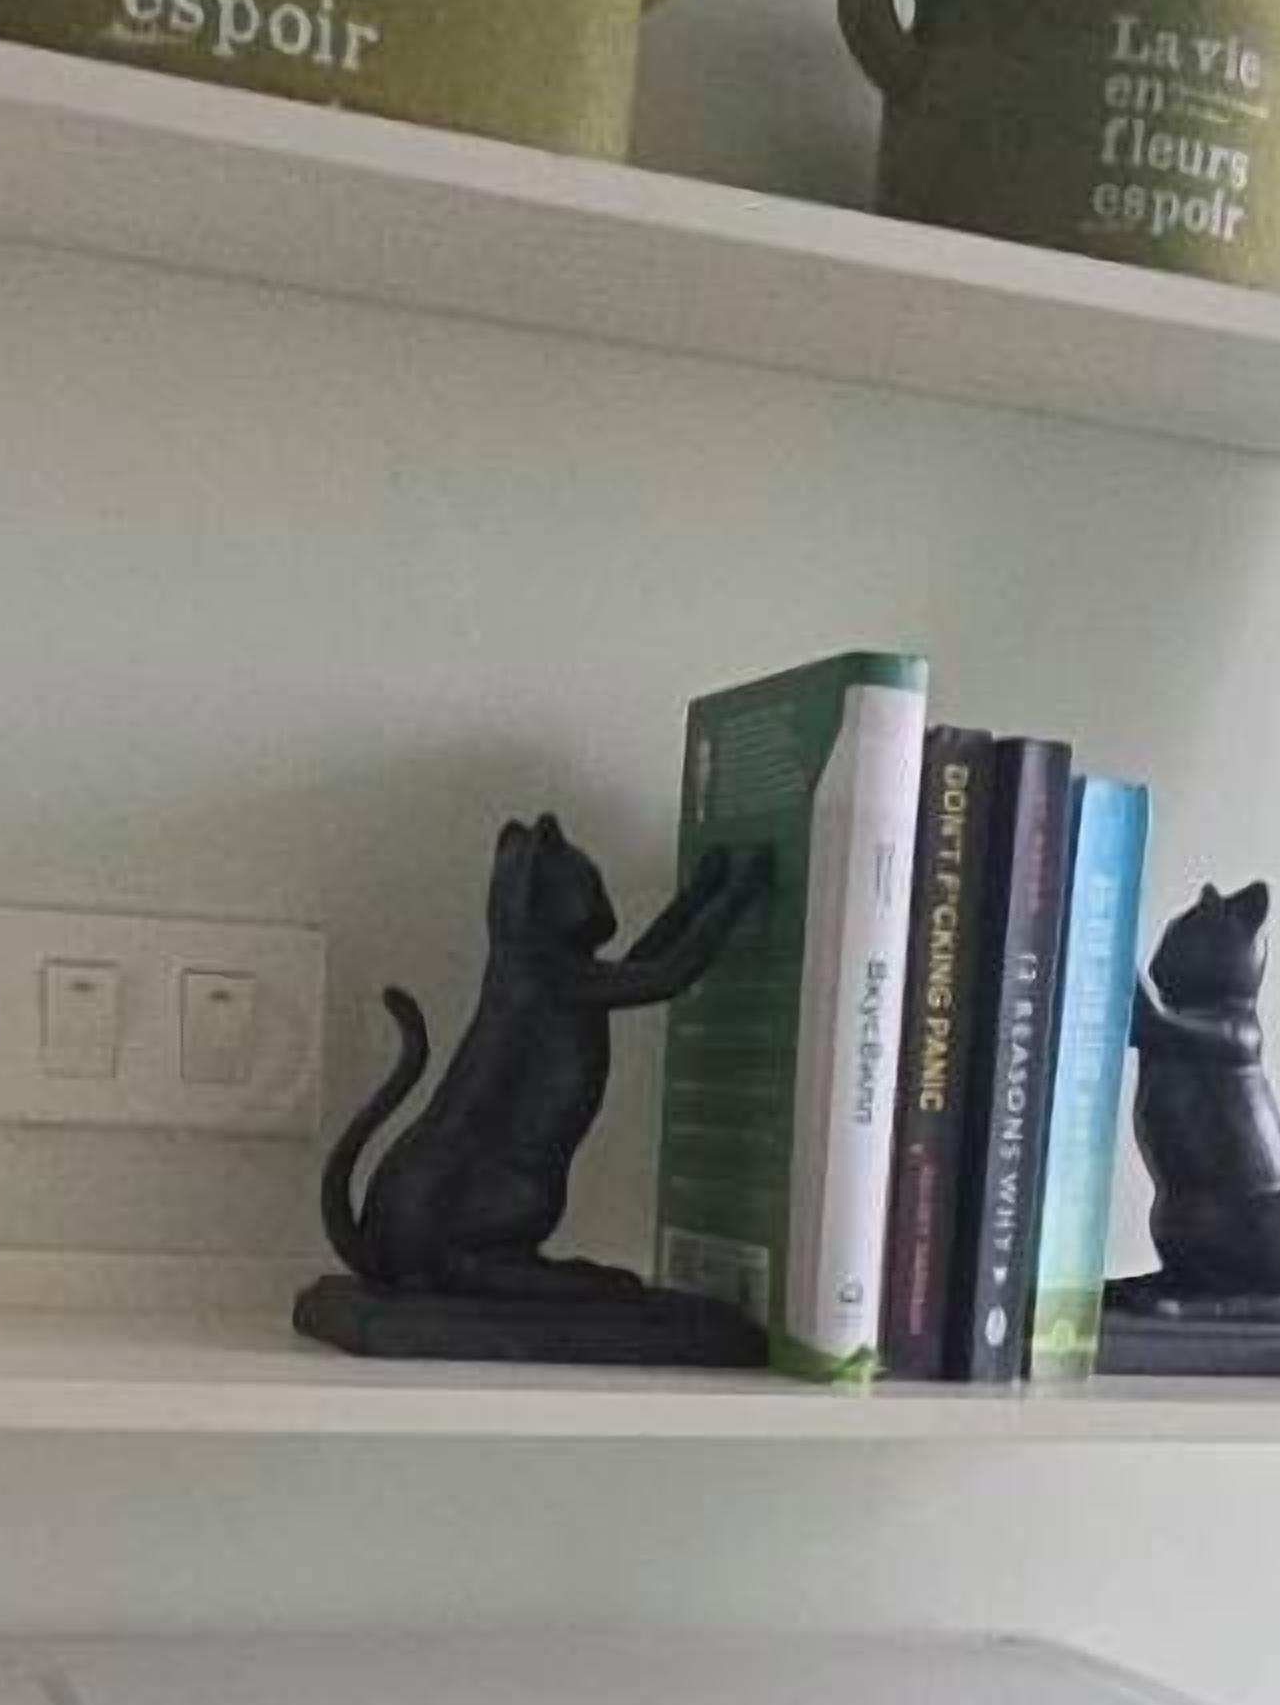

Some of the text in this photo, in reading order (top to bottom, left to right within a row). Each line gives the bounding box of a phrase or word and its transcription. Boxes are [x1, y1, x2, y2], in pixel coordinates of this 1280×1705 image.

[1112, 13, 1262, 89] La vie
[1103, 73, 1165, 114] en
[1100, 114, 1250, 192] fleurs
[1091, 183, 1245, 242] espoir
[935, 763, 969, 864] DON'T
[920, 1016, 951, 1111] PANIC
[998, 1001, 1034, 1160] REASONS
[992, 1171, 1018, 1252] WHY
